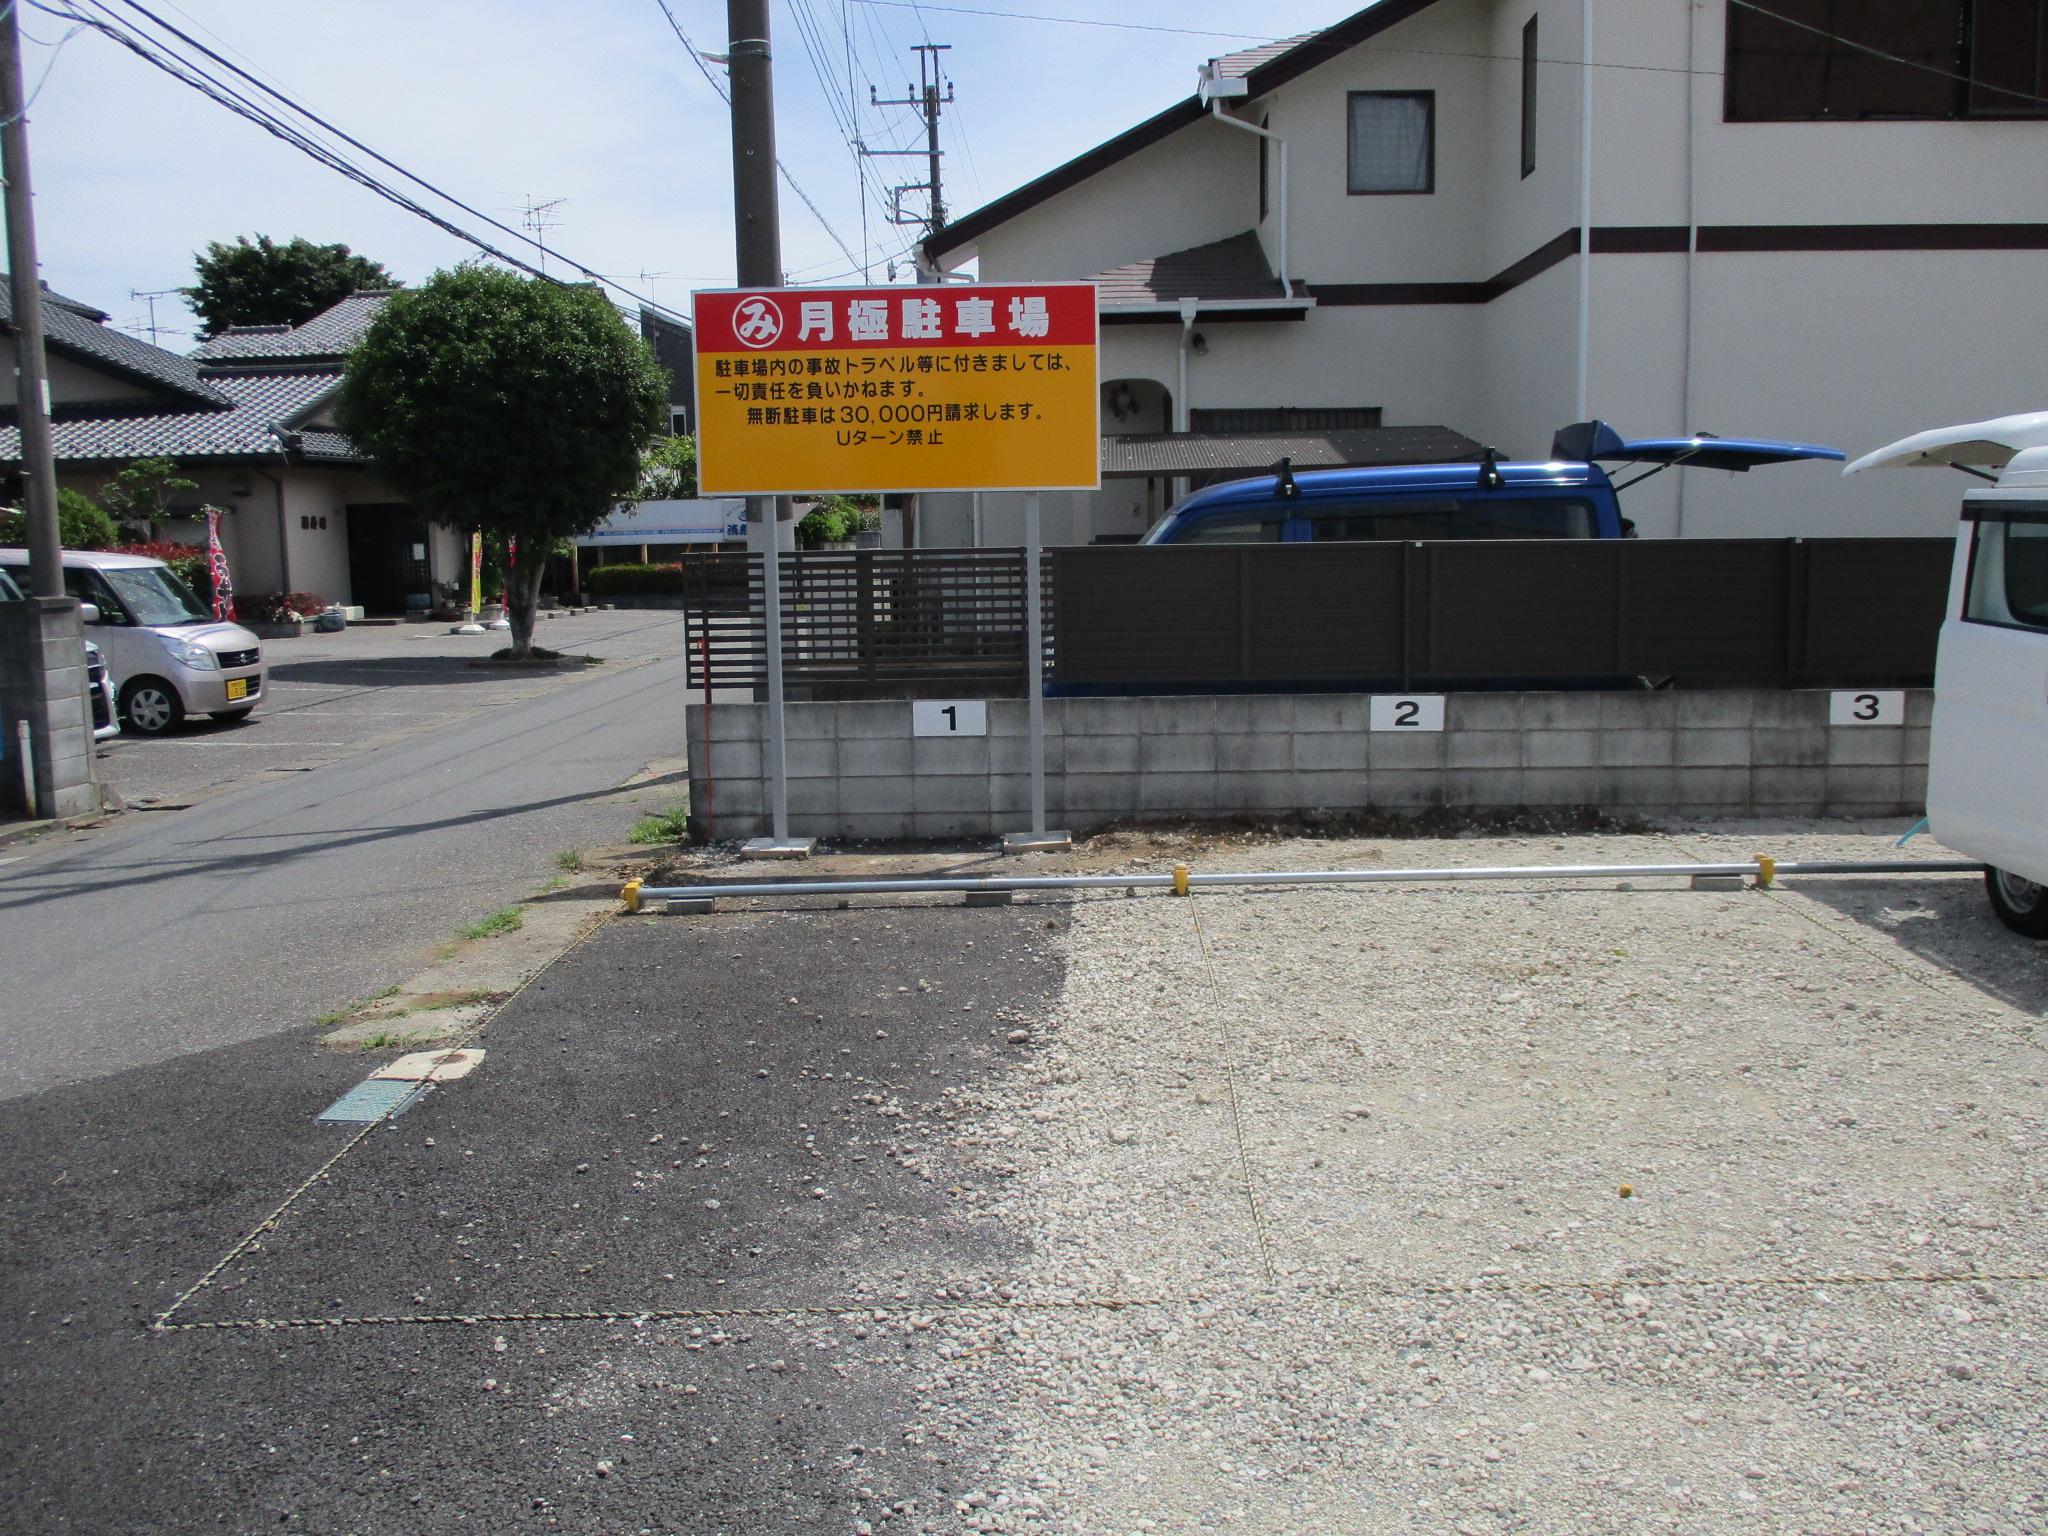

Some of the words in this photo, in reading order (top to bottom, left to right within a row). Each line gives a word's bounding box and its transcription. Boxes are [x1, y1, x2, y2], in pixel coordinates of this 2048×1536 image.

[798, 297, 1050, 342] 月極駐車場
[716, 379, 924, 401] 一切責任を負いかねます。
[747, 401, 1042, 426] 無断駐車は30,000円請求します。
[837, 429, 943, 446] Uターン禁止
[942, 706, 956, 731] 1
[1394, 701, 1420, 726] 2
[1853, 694, 1879, 720] 3
